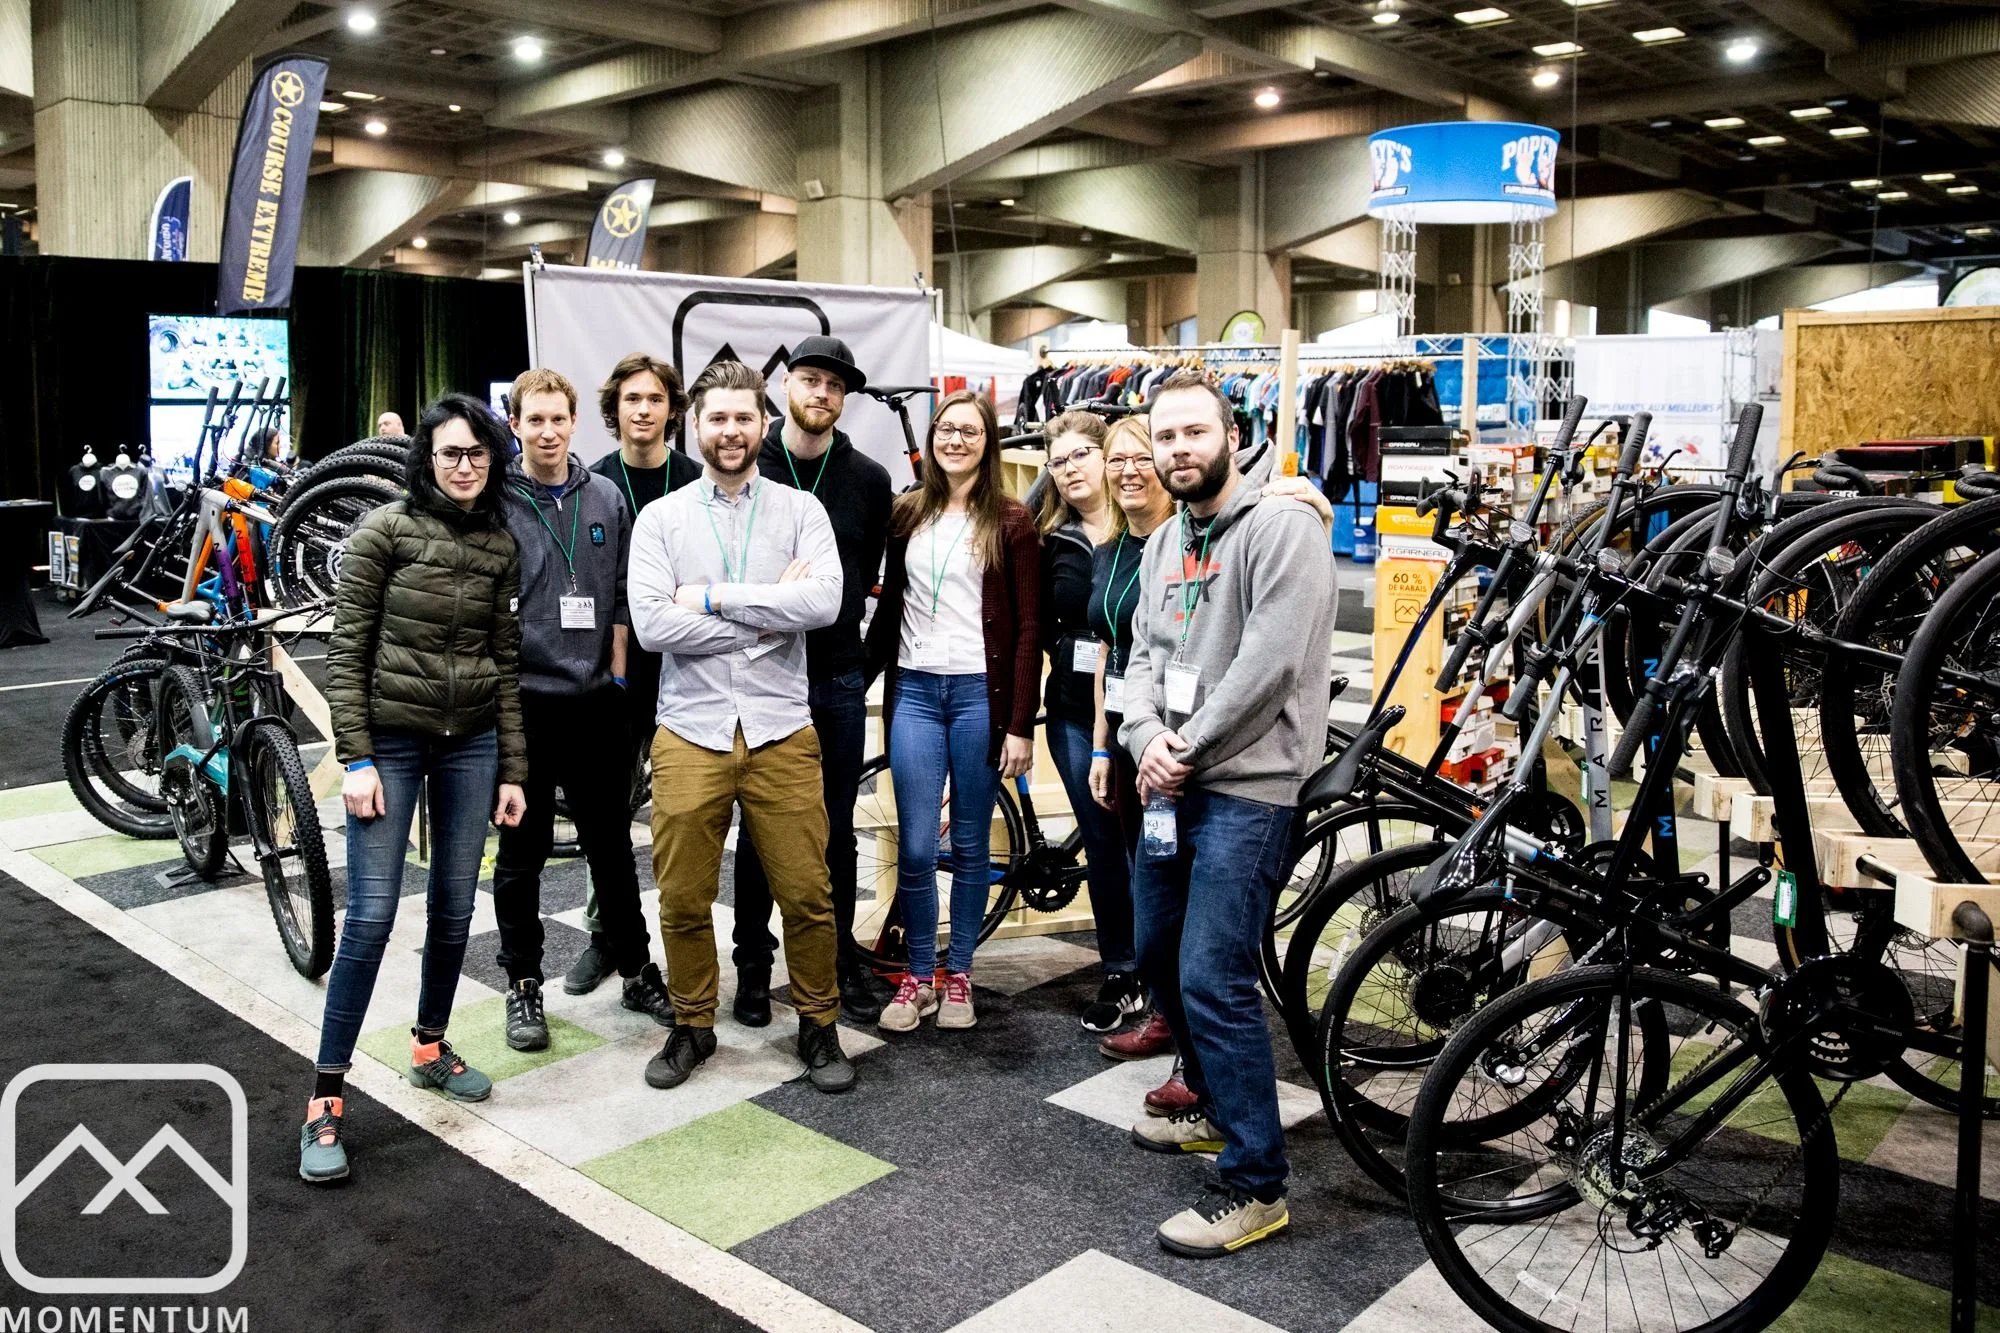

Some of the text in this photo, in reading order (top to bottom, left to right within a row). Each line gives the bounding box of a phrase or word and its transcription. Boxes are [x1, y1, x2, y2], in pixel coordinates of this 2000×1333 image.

[242, 106, 294, 303] COURSE EXTREME
[1395, 548, 1449, 558] GARNEAU
[1393, 573, 1423, 585] 60 %
[1399, 585, 1427, 593] RABAIS
[1586, 650, 1608, 808] MARIN
